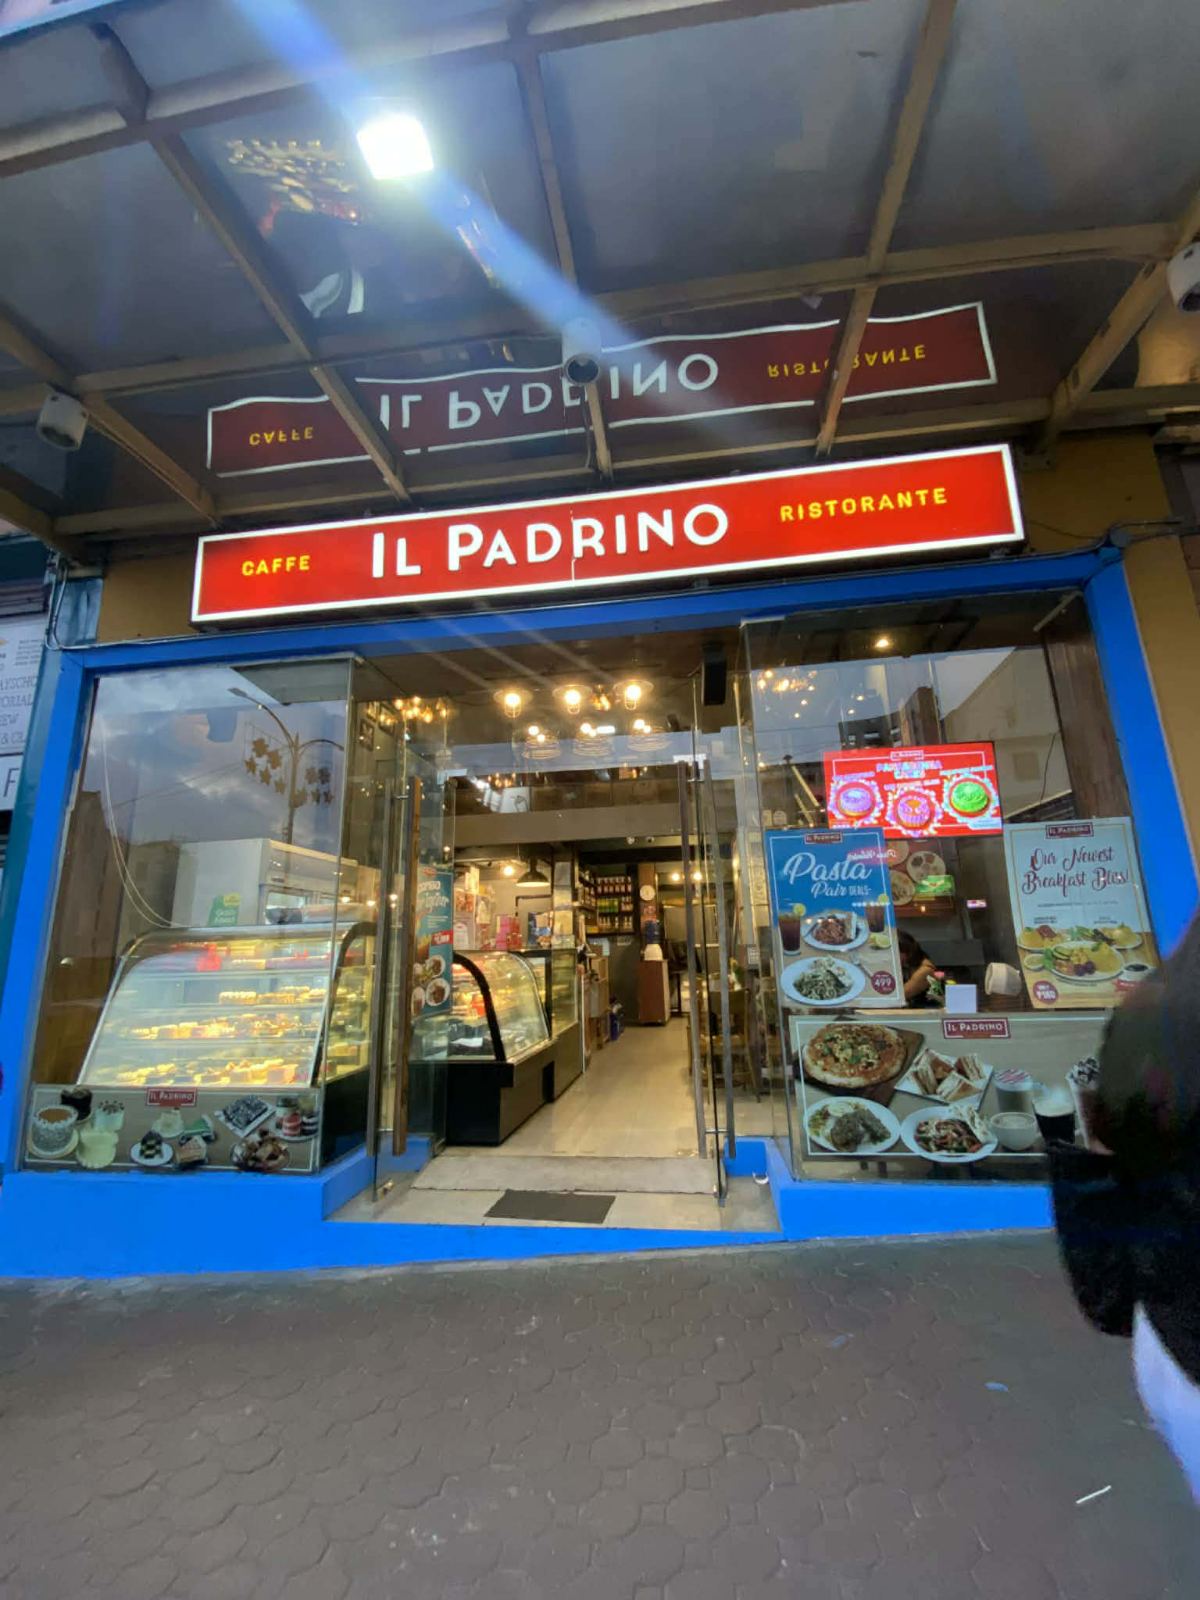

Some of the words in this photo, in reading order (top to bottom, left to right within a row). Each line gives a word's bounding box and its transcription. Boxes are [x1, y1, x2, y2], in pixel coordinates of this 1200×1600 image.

[241, 555, 312, 577] CAFFE
[372, 532, 421, 578] IL
[448, 503, 728, 572] PADRINO
[780, 487, 948, 523] RISTORANTE
[783, 852, 872, 885] Pasta
[1030, 848, 1056, 871] Our
[1063, 846, 1114, 872] Newest
[811, 881, 848, 898] Pair
[1022, 870, 1086, 898] Breakfast
[947, 1023, 958, 1032] IL
[960, 1022, 1003, 1032] PADRINO
